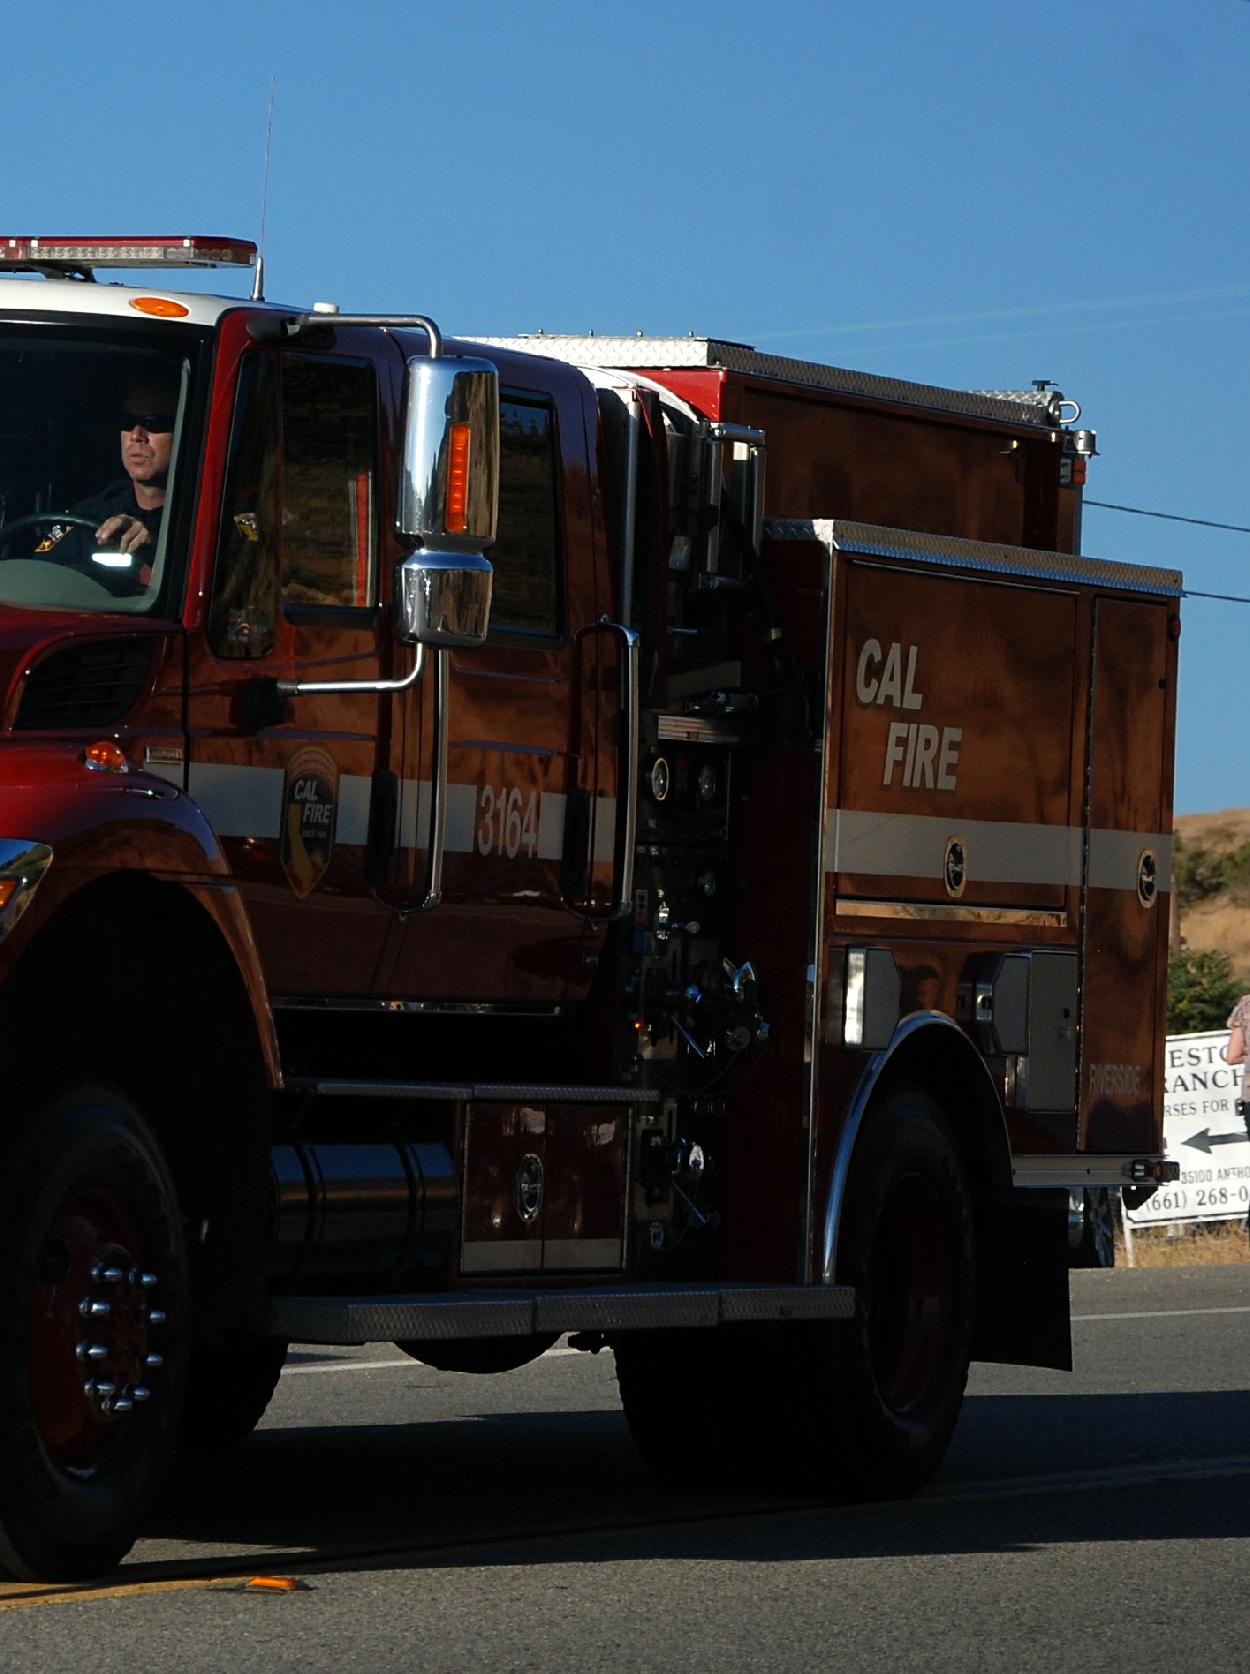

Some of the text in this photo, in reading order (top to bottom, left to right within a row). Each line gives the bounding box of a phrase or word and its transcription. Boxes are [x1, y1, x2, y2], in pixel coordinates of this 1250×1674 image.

[856, 638, 923, 710] CAL
[883, 722, 963, 791] FIRE
[294, 779, 318, 800] CAL
[302, 803, 332, 823] FIRE
[478, 784, 537, 859] 3164
[1089, 1063, 1140, 1096] RIVERSIDE
[1165, 1069, 1243, 1093] ANCH
[1203, 1100, 1229, 1114] FOR
[1180, 1169, 1212, 1185] 35100
[1145, 1190, 1187, 1213] (661)
